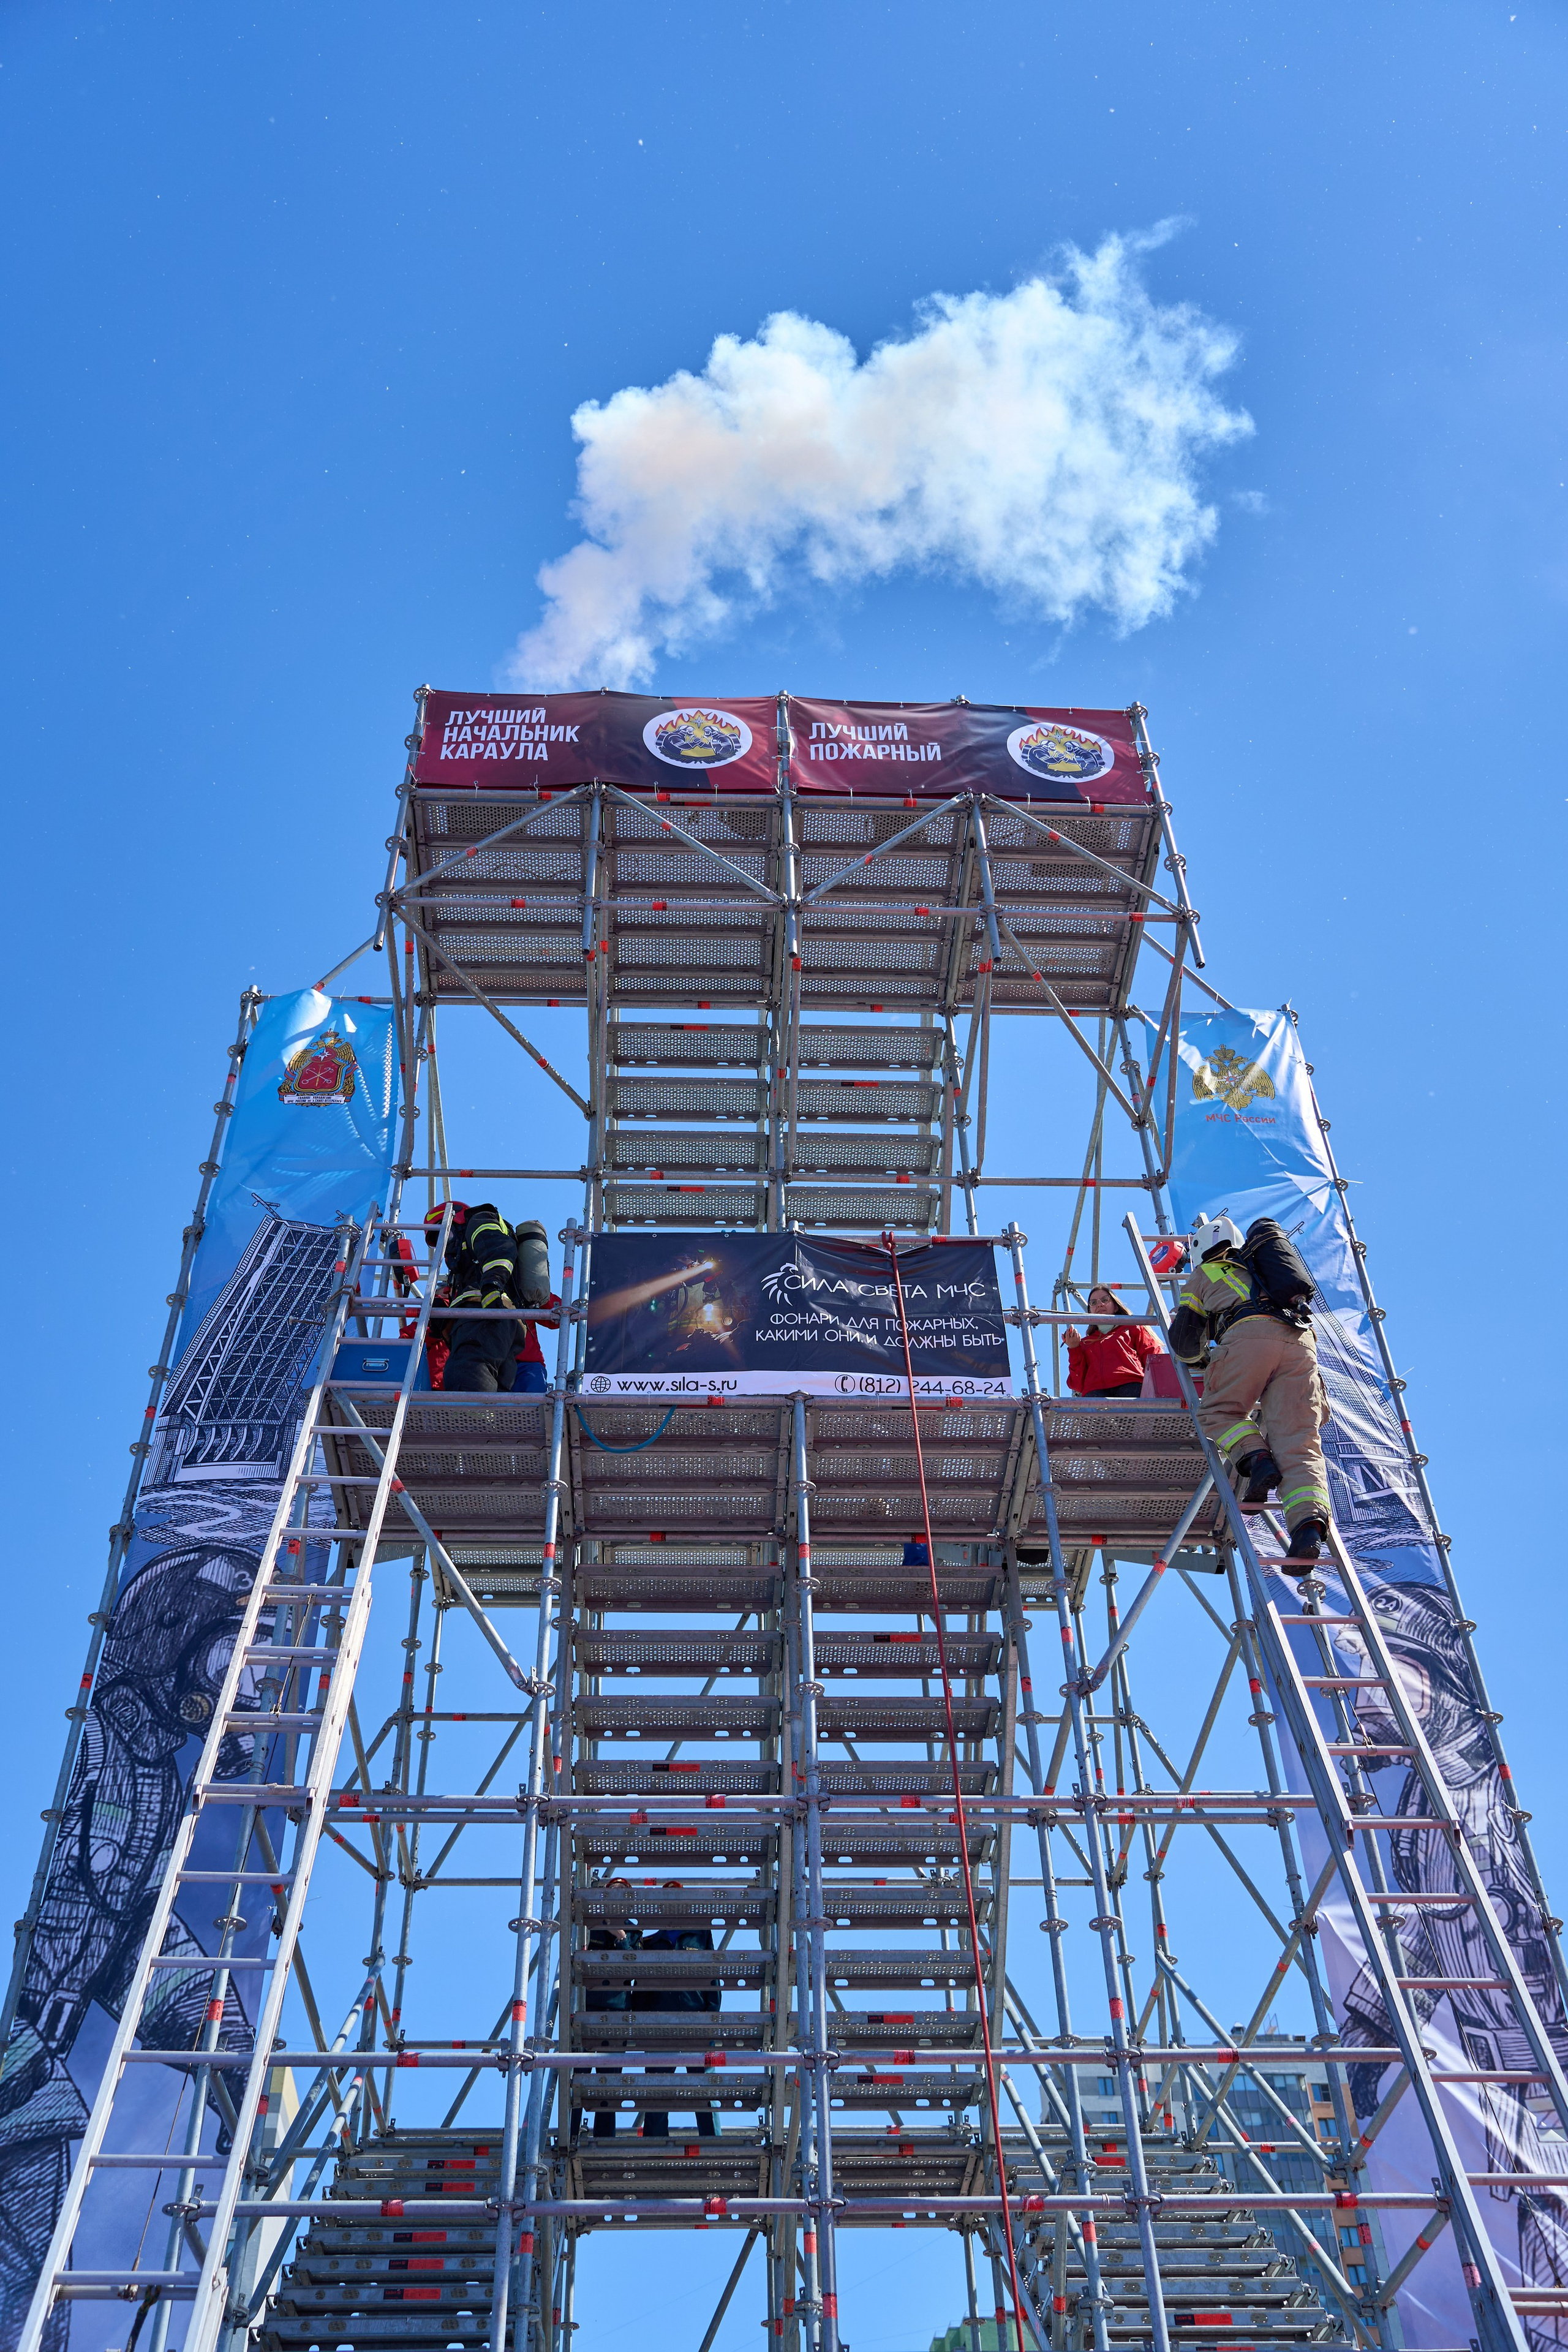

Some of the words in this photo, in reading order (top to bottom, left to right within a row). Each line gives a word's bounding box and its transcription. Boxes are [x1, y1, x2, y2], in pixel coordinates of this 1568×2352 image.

[445, 707, 546, 725] ЛУЧШИЙ
[443, 725, 581, 743] НАЧАЛЬНИК
[809, 723, 908, 741] ЛУЧШИЙ
[439, 742, 549, 761] КАРАУЛА
[810, 743, 941, 761] ПОЖАРНЫЙ
[1206, 1114, 1231, 1123] МЧС
[1235, 1114, 1276, 1124] России
[783, 1274, 850, 1293] СИЛА
[858, 1284, 927, 1298] СВЕТА
[937, 1283, 986, 1299] МЧС
[770, 1313, 839, 1326] ФОНАРИ
[846, 1316, 879, 1330] ДЛЯ
[756, 1329, 818, 1343] КАКИМИ
[866, 1334, 877, 1345] И
[883, 1335, 956, 1349] ДОЛЖНЫ
[962, 1333, 1001, 1346] БЫТЬ
[617, 1376, 737, 1392] www.sila-s.ru
[859, 1378, 901, 1394] (812)
[913, 1381, 1006, 1395] 244-68-24
